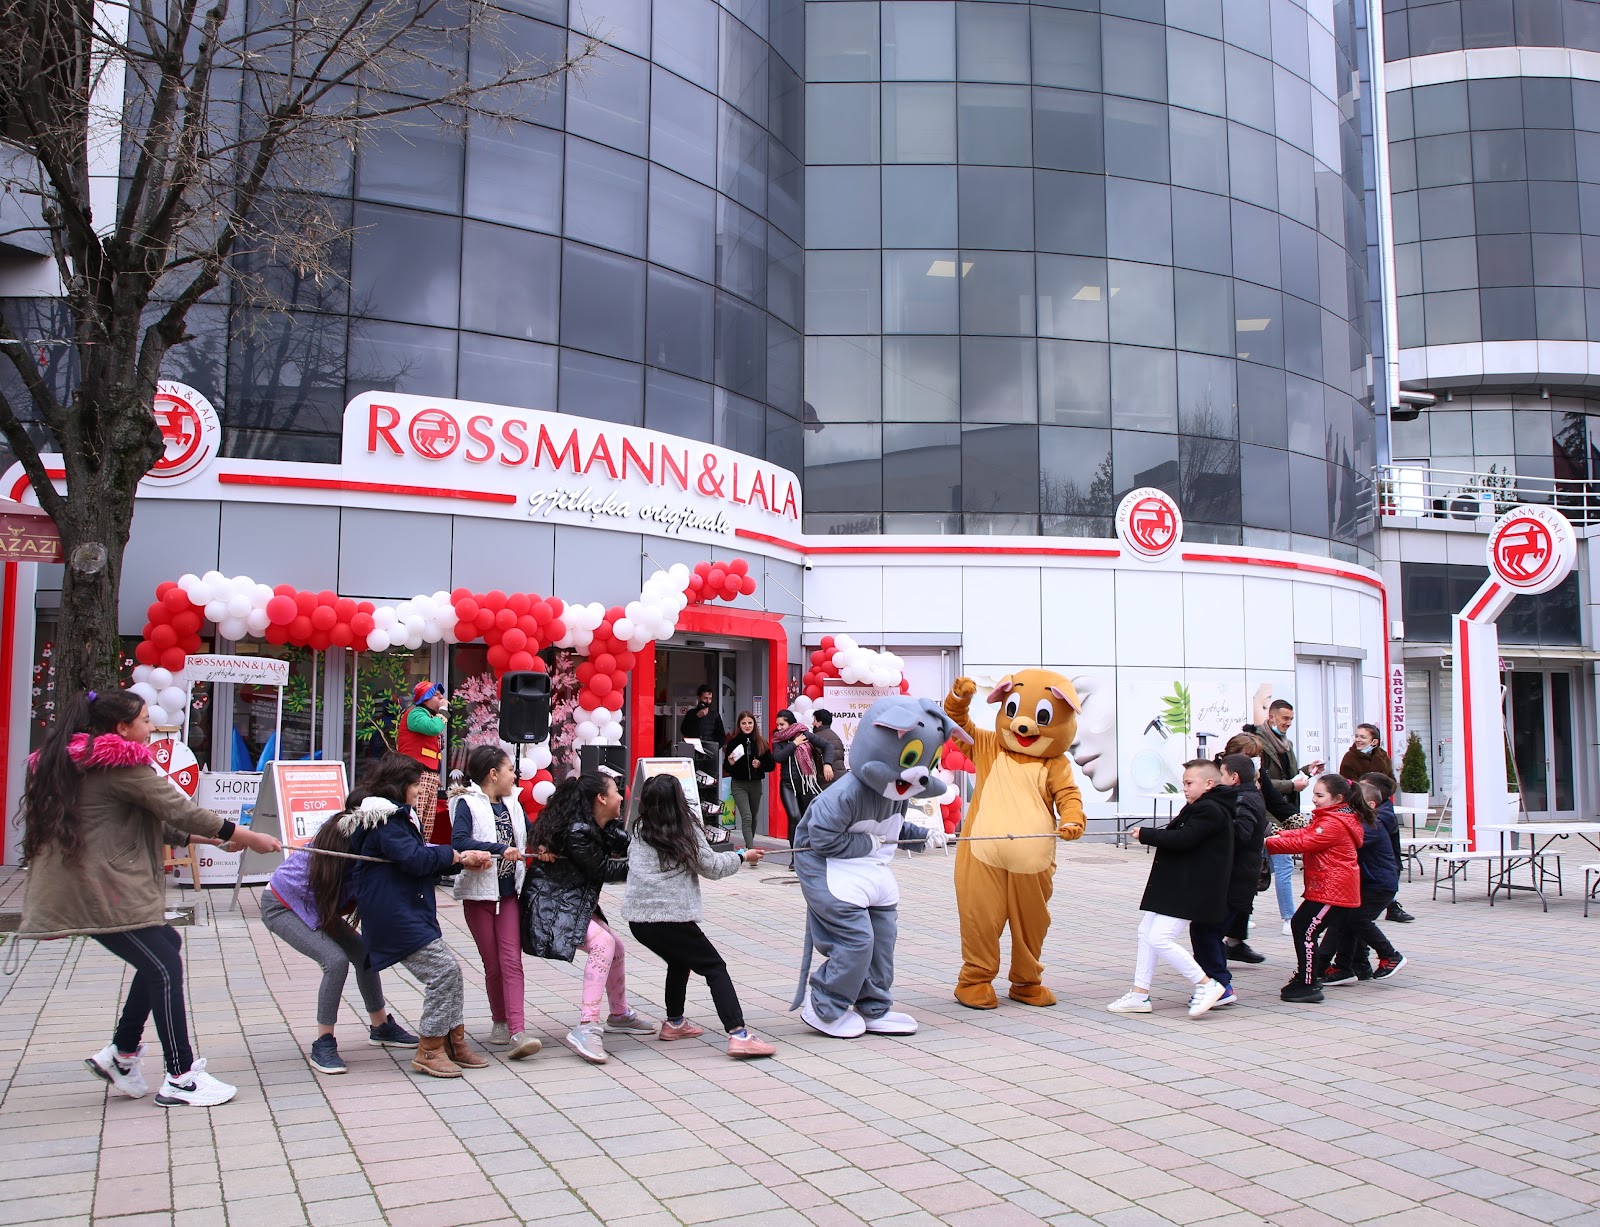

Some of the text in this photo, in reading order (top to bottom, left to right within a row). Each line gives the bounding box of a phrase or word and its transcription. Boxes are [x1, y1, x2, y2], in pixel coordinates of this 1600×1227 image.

[195, 399, 216, 433] LALA
[528, 485, 731, 535] gjithçka origjinale
[1119, 490, 1158, 522] ROSSMANN
[1488, 508, 1535, 552] ROSSMANN
[1547, 516, 1565, 544] LALA
[1392, 669, 1405, 732] ARGJEND
[215, 779, 261, 794] SHORT
[303, 800, 327, 810] STOP
[199, 858, 213, 867] 50
